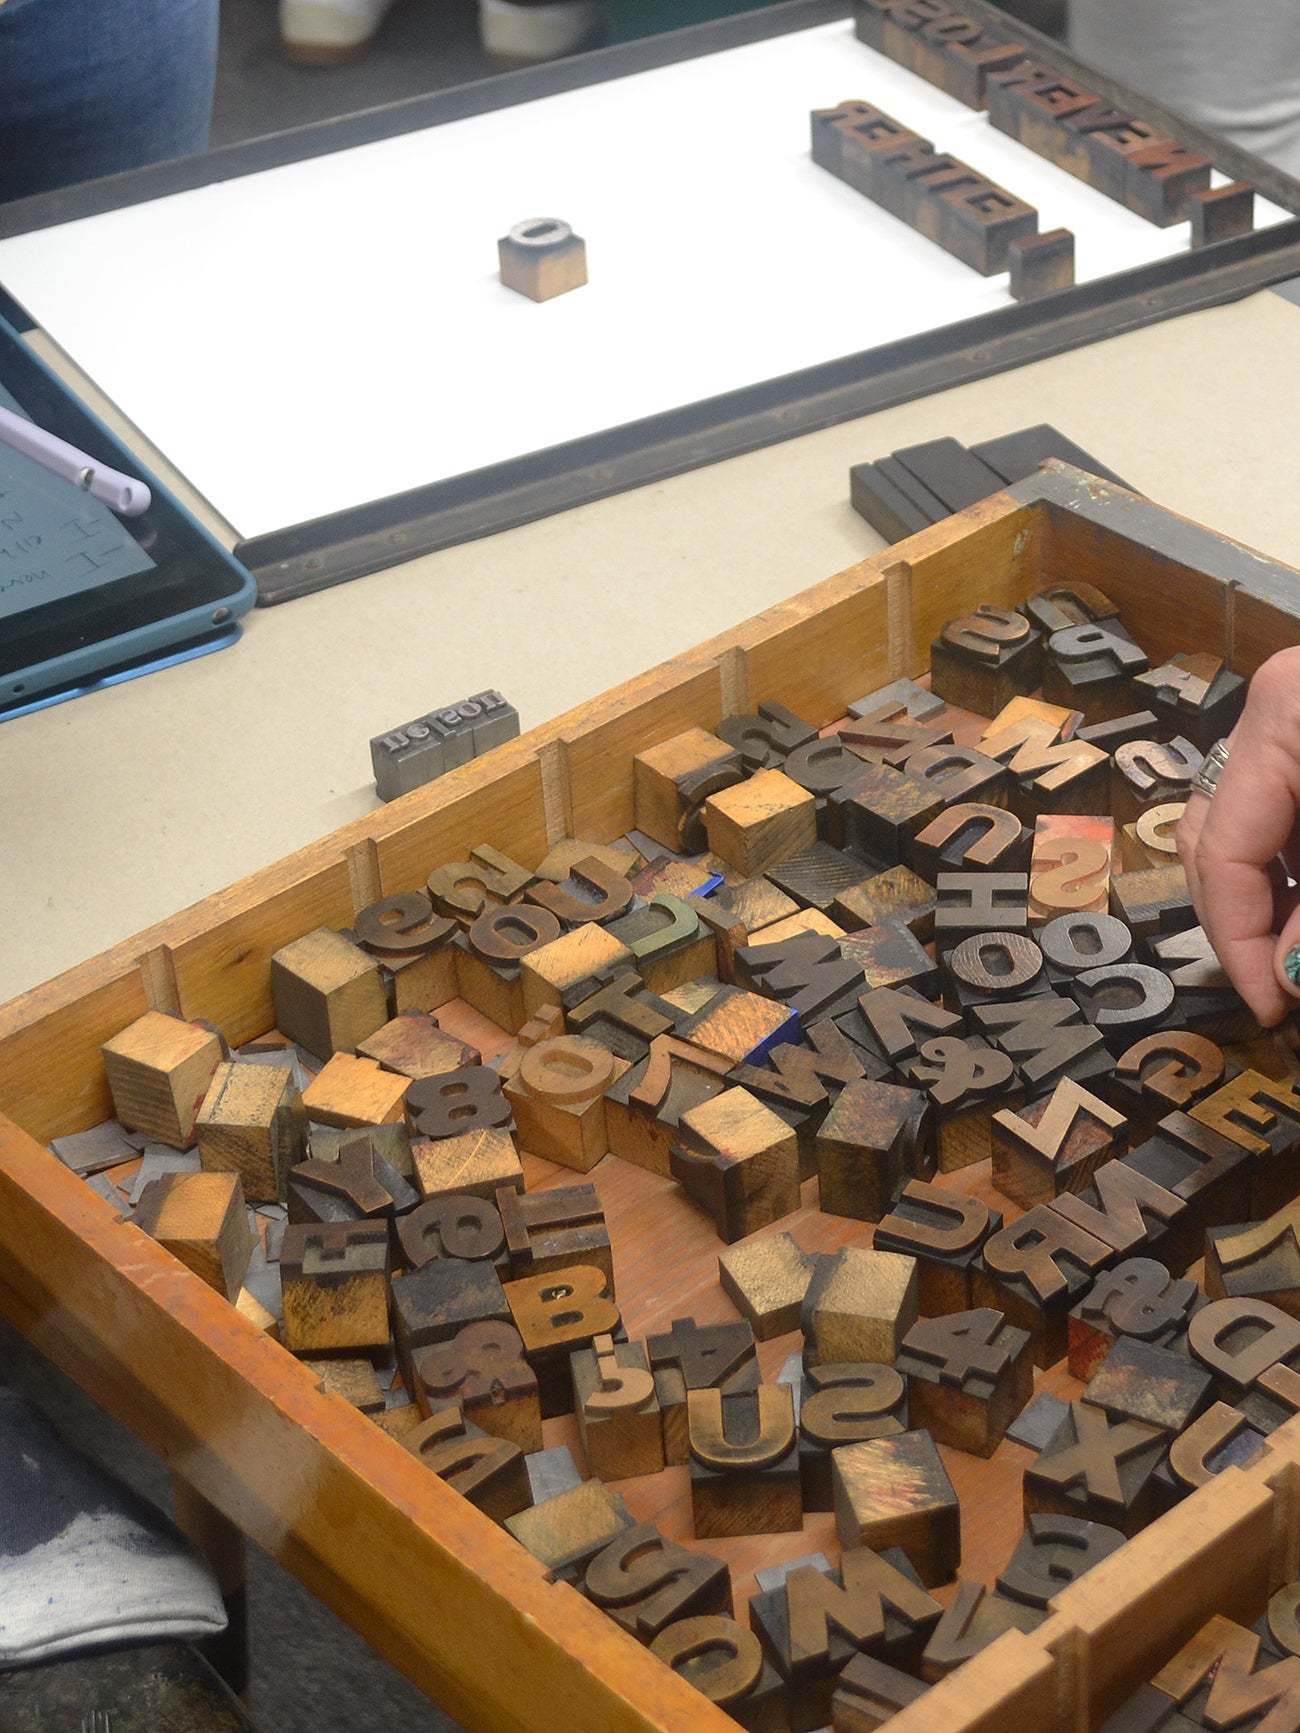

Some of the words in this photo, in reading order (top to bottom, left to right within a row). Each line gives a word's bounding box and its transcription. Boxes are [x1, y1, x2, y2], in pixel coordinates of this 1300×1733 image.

[936, 872, 1028, 928] H
[951, 932, 1043, 989] O
[1040, 911, 1133, 969] O
[1025, 1402, 1170, 1508] X
